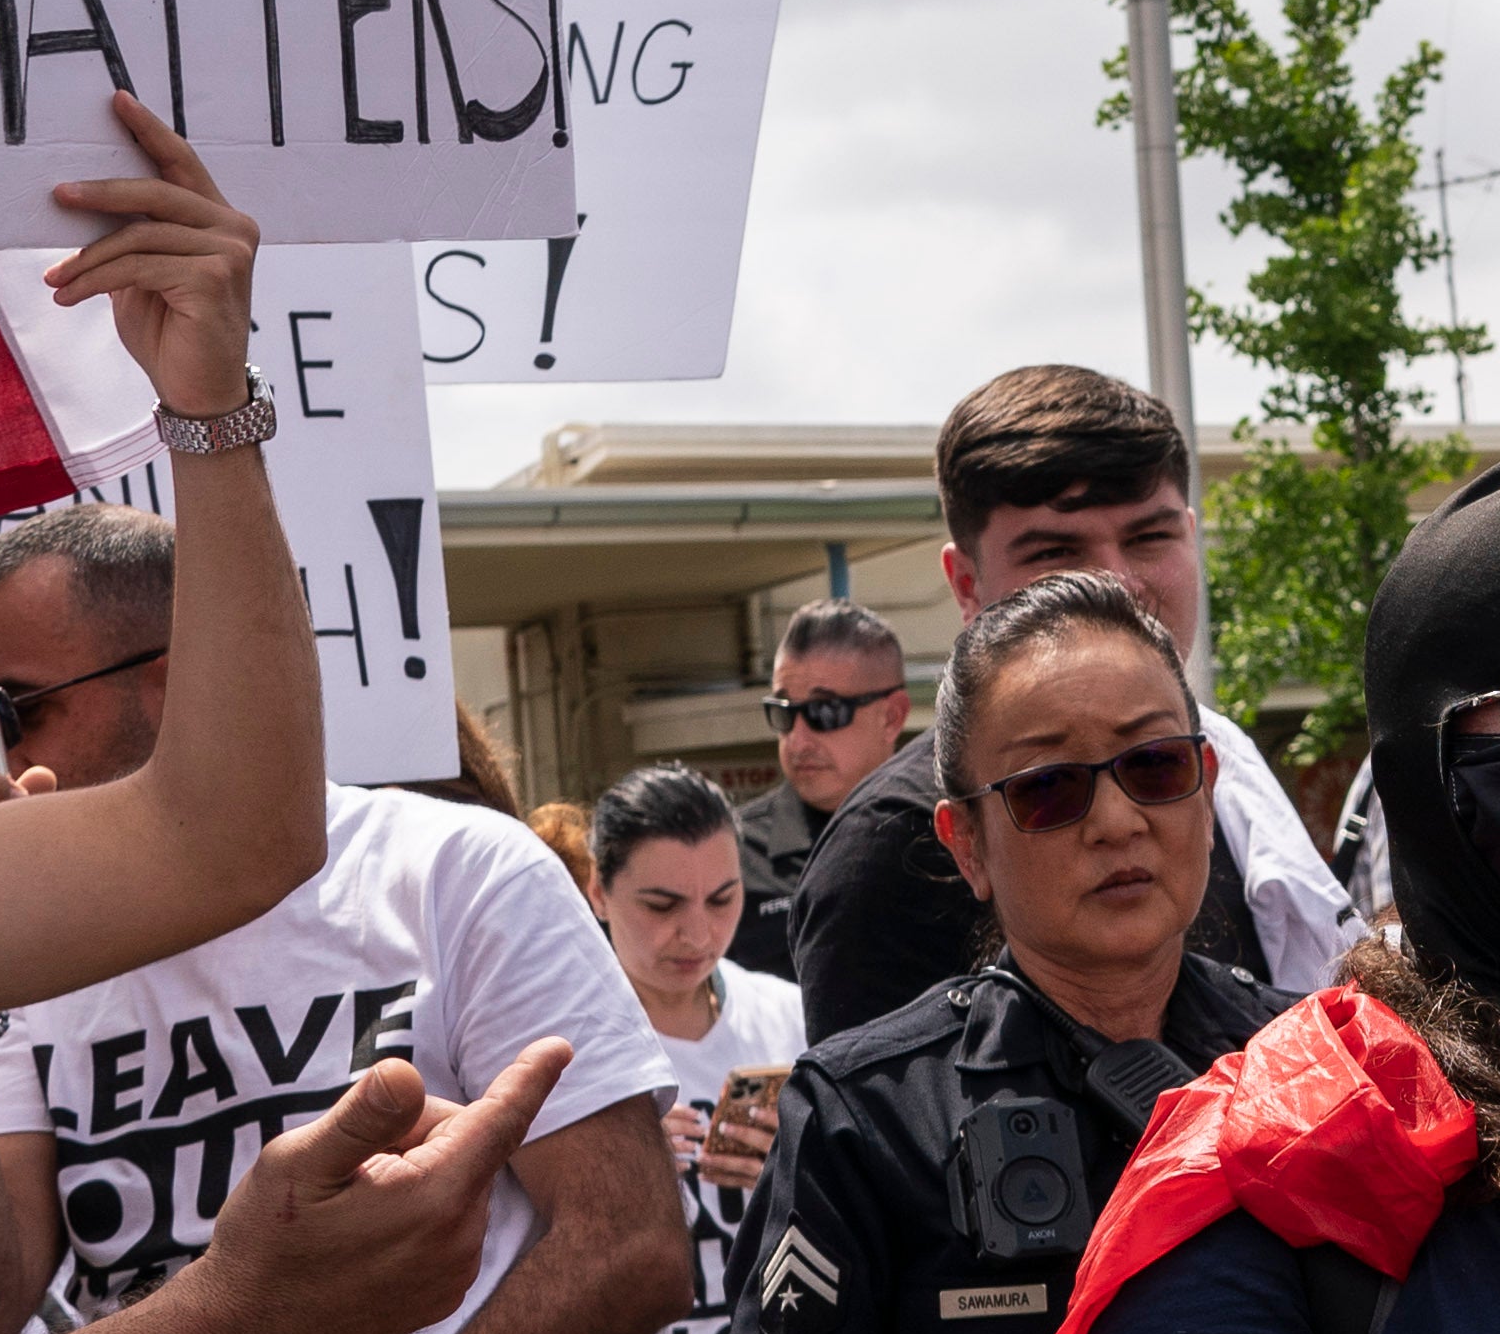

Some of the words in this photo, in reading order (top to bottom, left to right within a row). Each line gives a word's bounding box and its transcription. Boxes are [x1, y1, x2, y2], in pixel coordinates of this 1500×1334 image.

[32, 979, 418, 1137] LEAVE
[1028, 1228, 1056, 1240] AXON
[957, 1292, 1031, 1311] SAWAMURA
